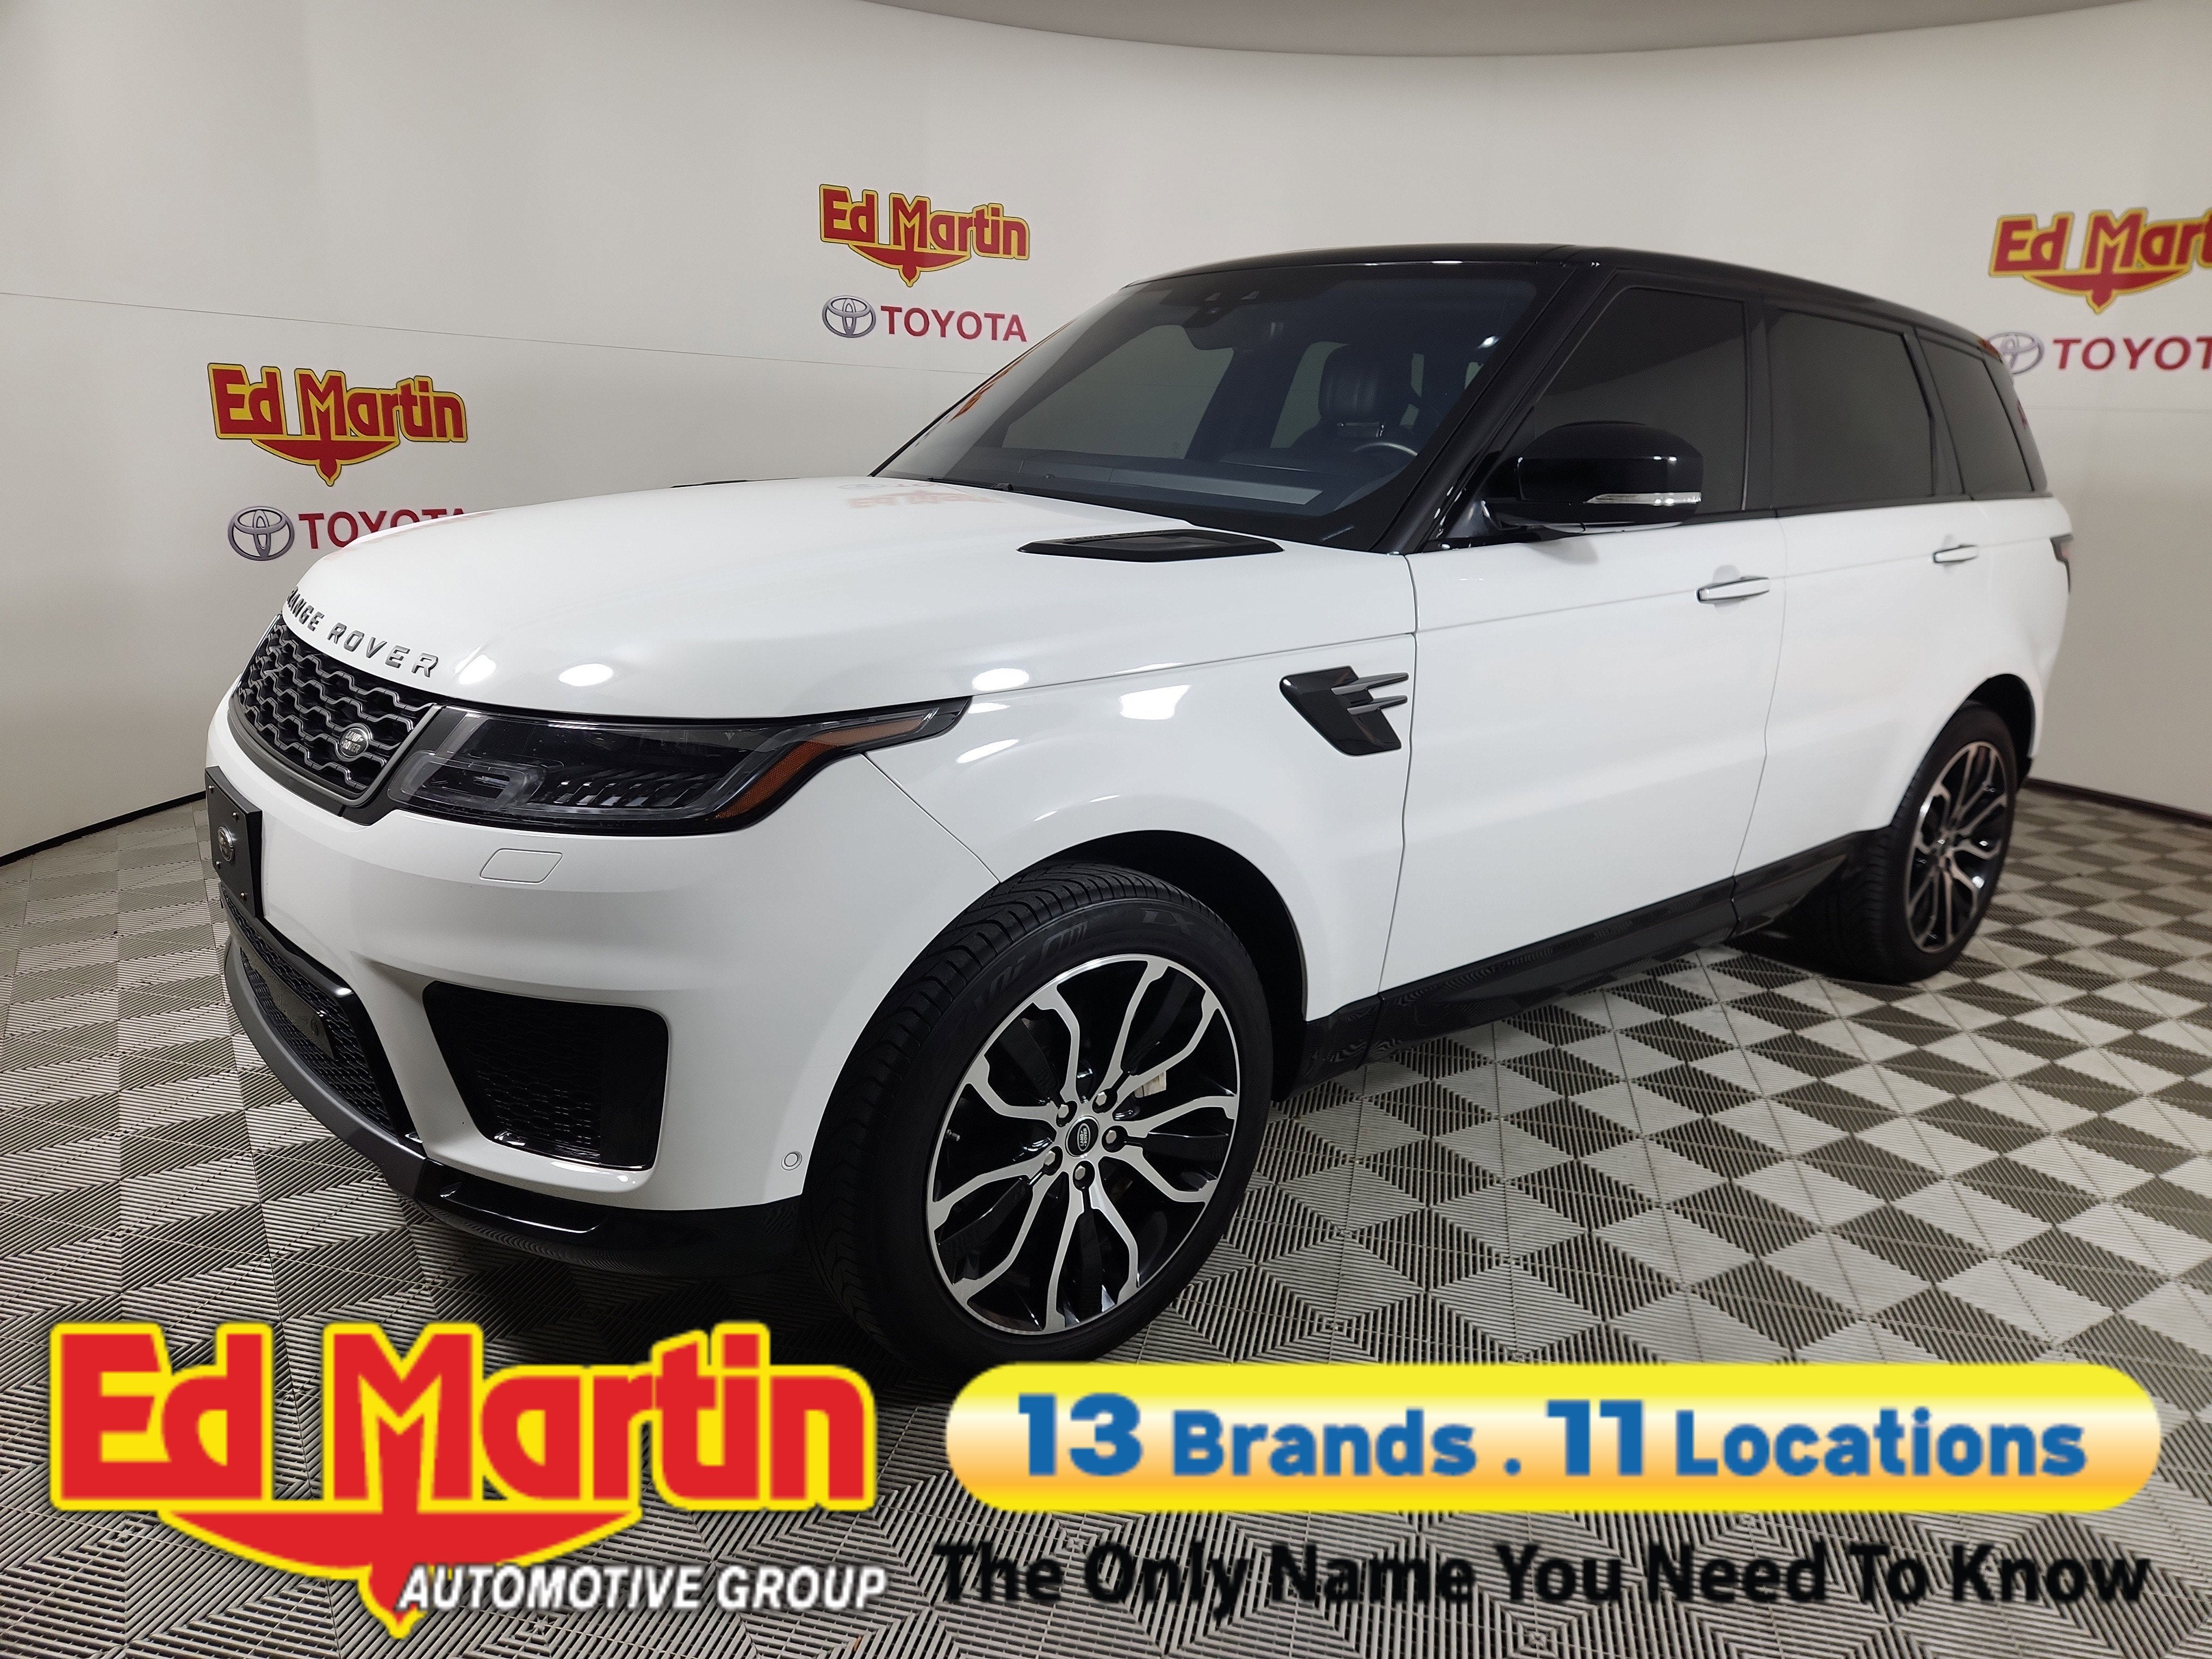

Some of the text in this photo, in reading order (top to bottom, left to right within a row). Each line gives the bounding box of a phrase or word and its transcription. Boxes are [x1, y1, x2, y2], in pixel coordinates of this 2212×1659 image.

[820, 184, 1029, 259] Ed Martin
[1990, 208, 2212, 276] Ed Mar
[880, 305, 1027, 342] TOYOTA
[209, 365, 467, 441] Ed Martin
[298, 509, 465, 549] TOY
[326, 622, 439, 678] ROVER
